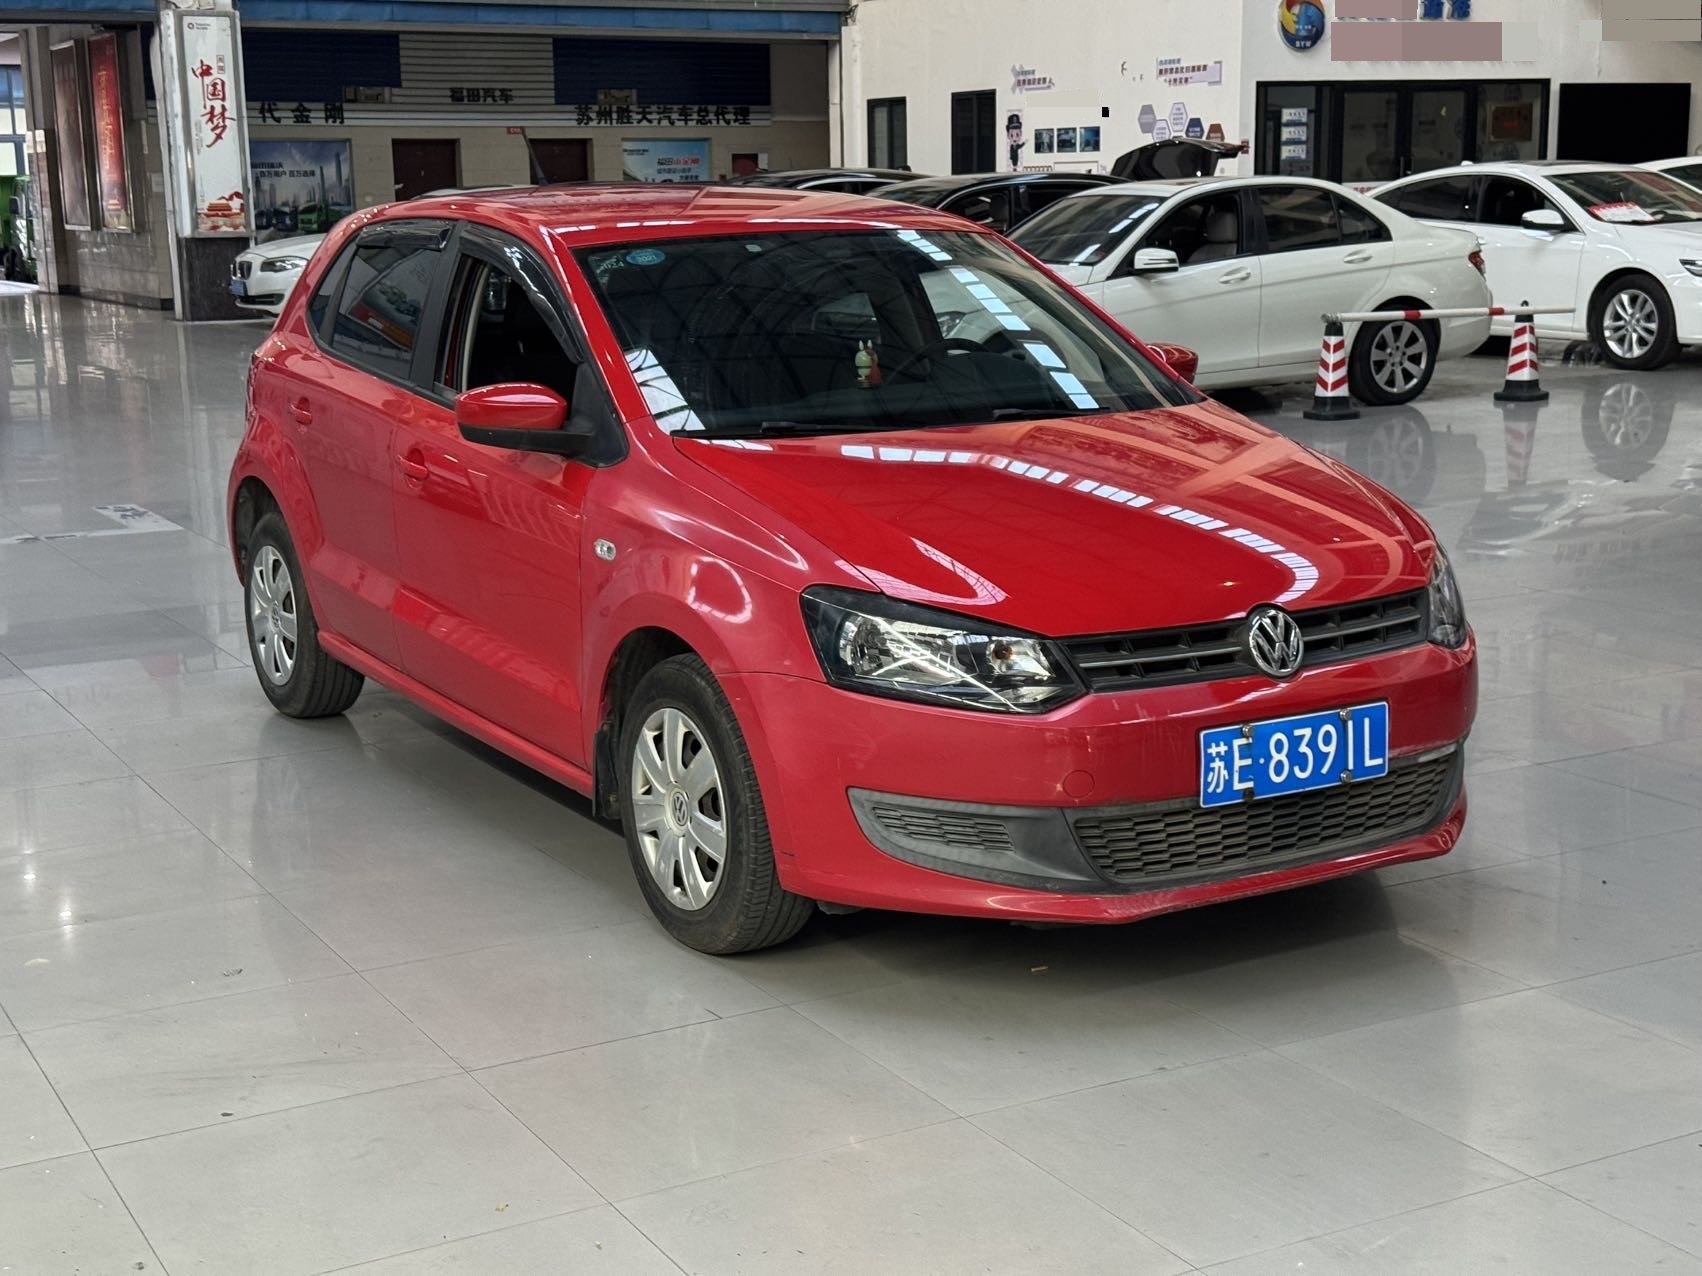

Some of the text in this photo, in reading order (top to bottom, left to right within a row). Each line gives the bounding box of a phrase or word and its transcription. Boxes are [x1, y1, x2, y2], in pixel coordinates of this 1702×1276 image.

[191, 59, 236, 148] 中国梦
[450, 87, 513, 103] 福田汽车
[575, 105, 751, 126] 苏州胜天汽车总代理
